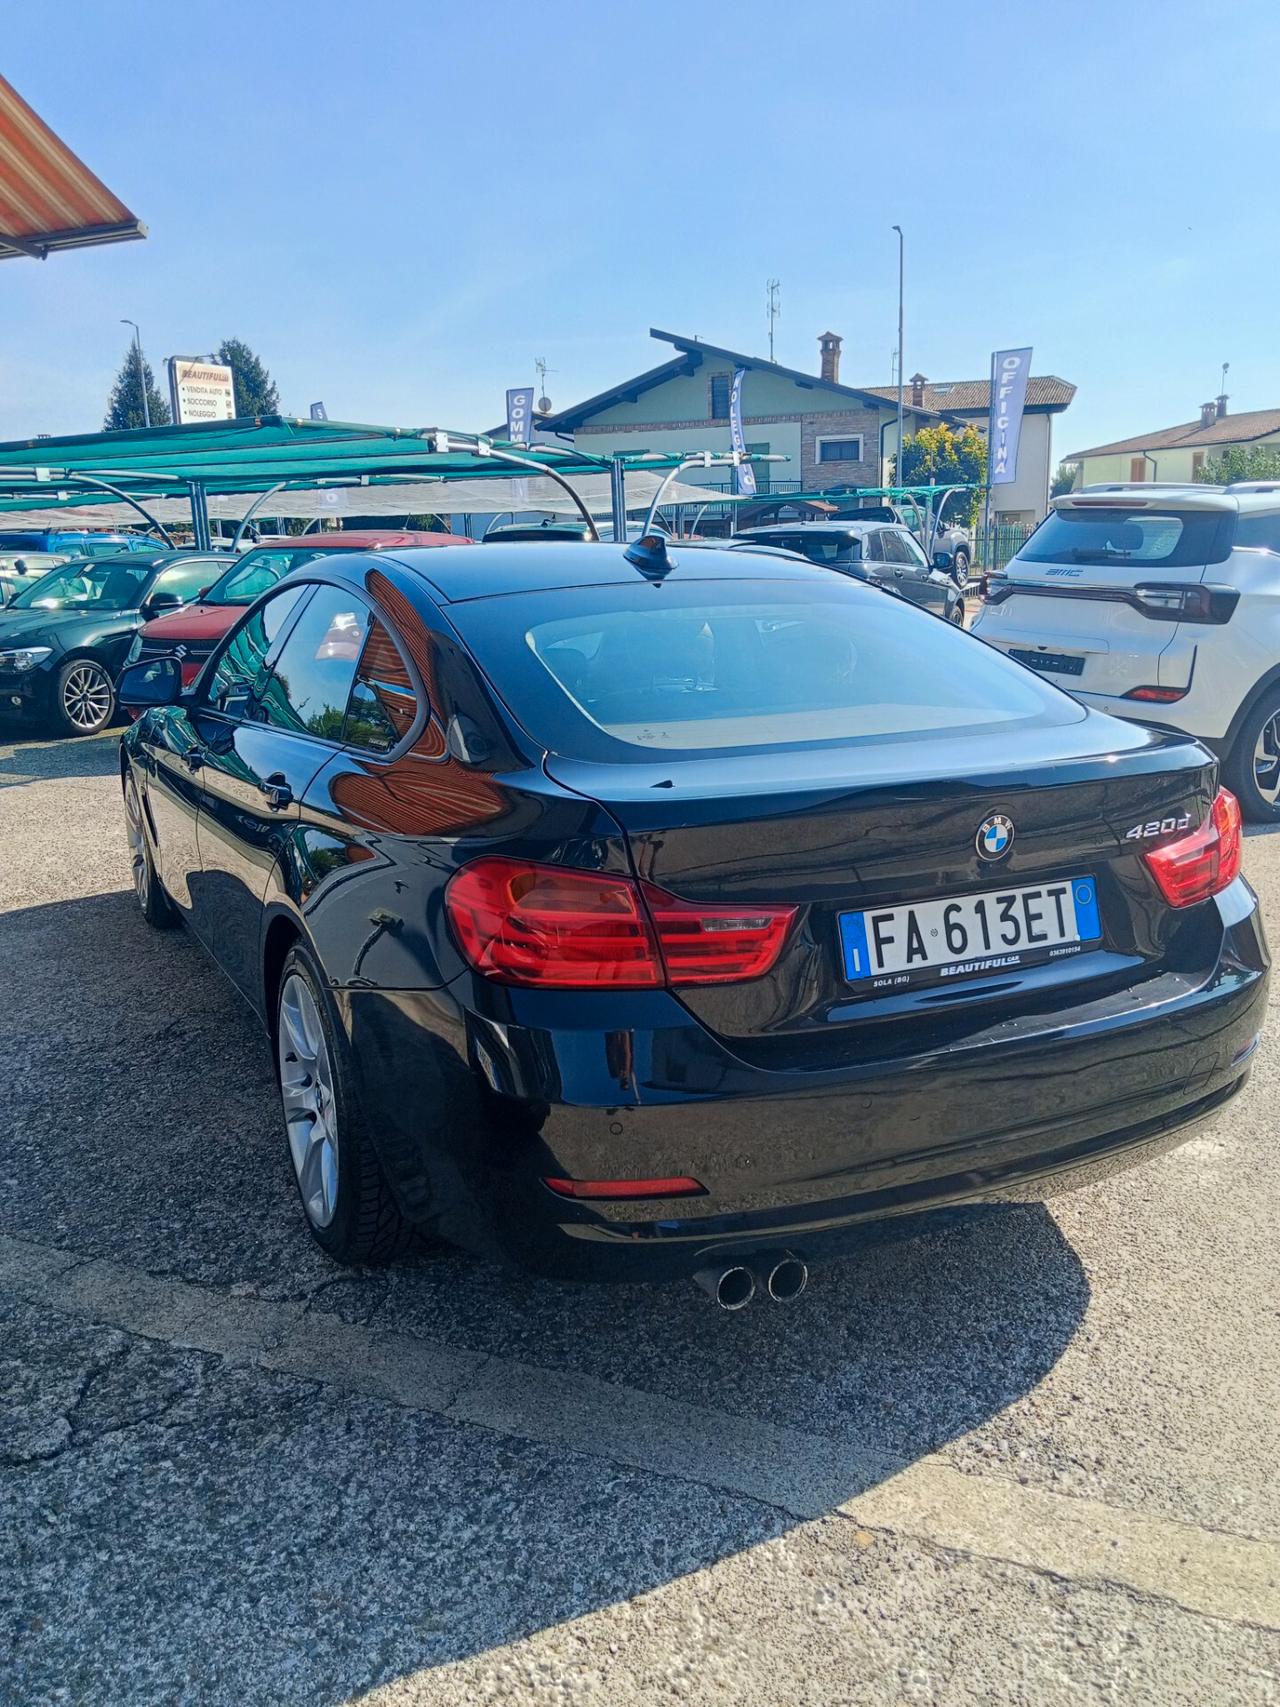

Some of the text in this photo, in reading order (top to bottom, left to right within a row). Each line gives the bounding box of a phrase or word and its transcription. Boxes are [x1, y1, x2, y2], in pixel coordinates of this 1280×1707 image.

[186, 386, 208, 394] VENDITA
[187, 398, 217, 406] SOCCORSO
[188, 410, 217, 418] NOLEGGIO
[995, 356, 1021, 474] OFFICINA
[1126, 812, 1191, 839] 420d
[871, 887, 1067, 969] FA 613ET
[873, 978, 892, 987] SOLA
